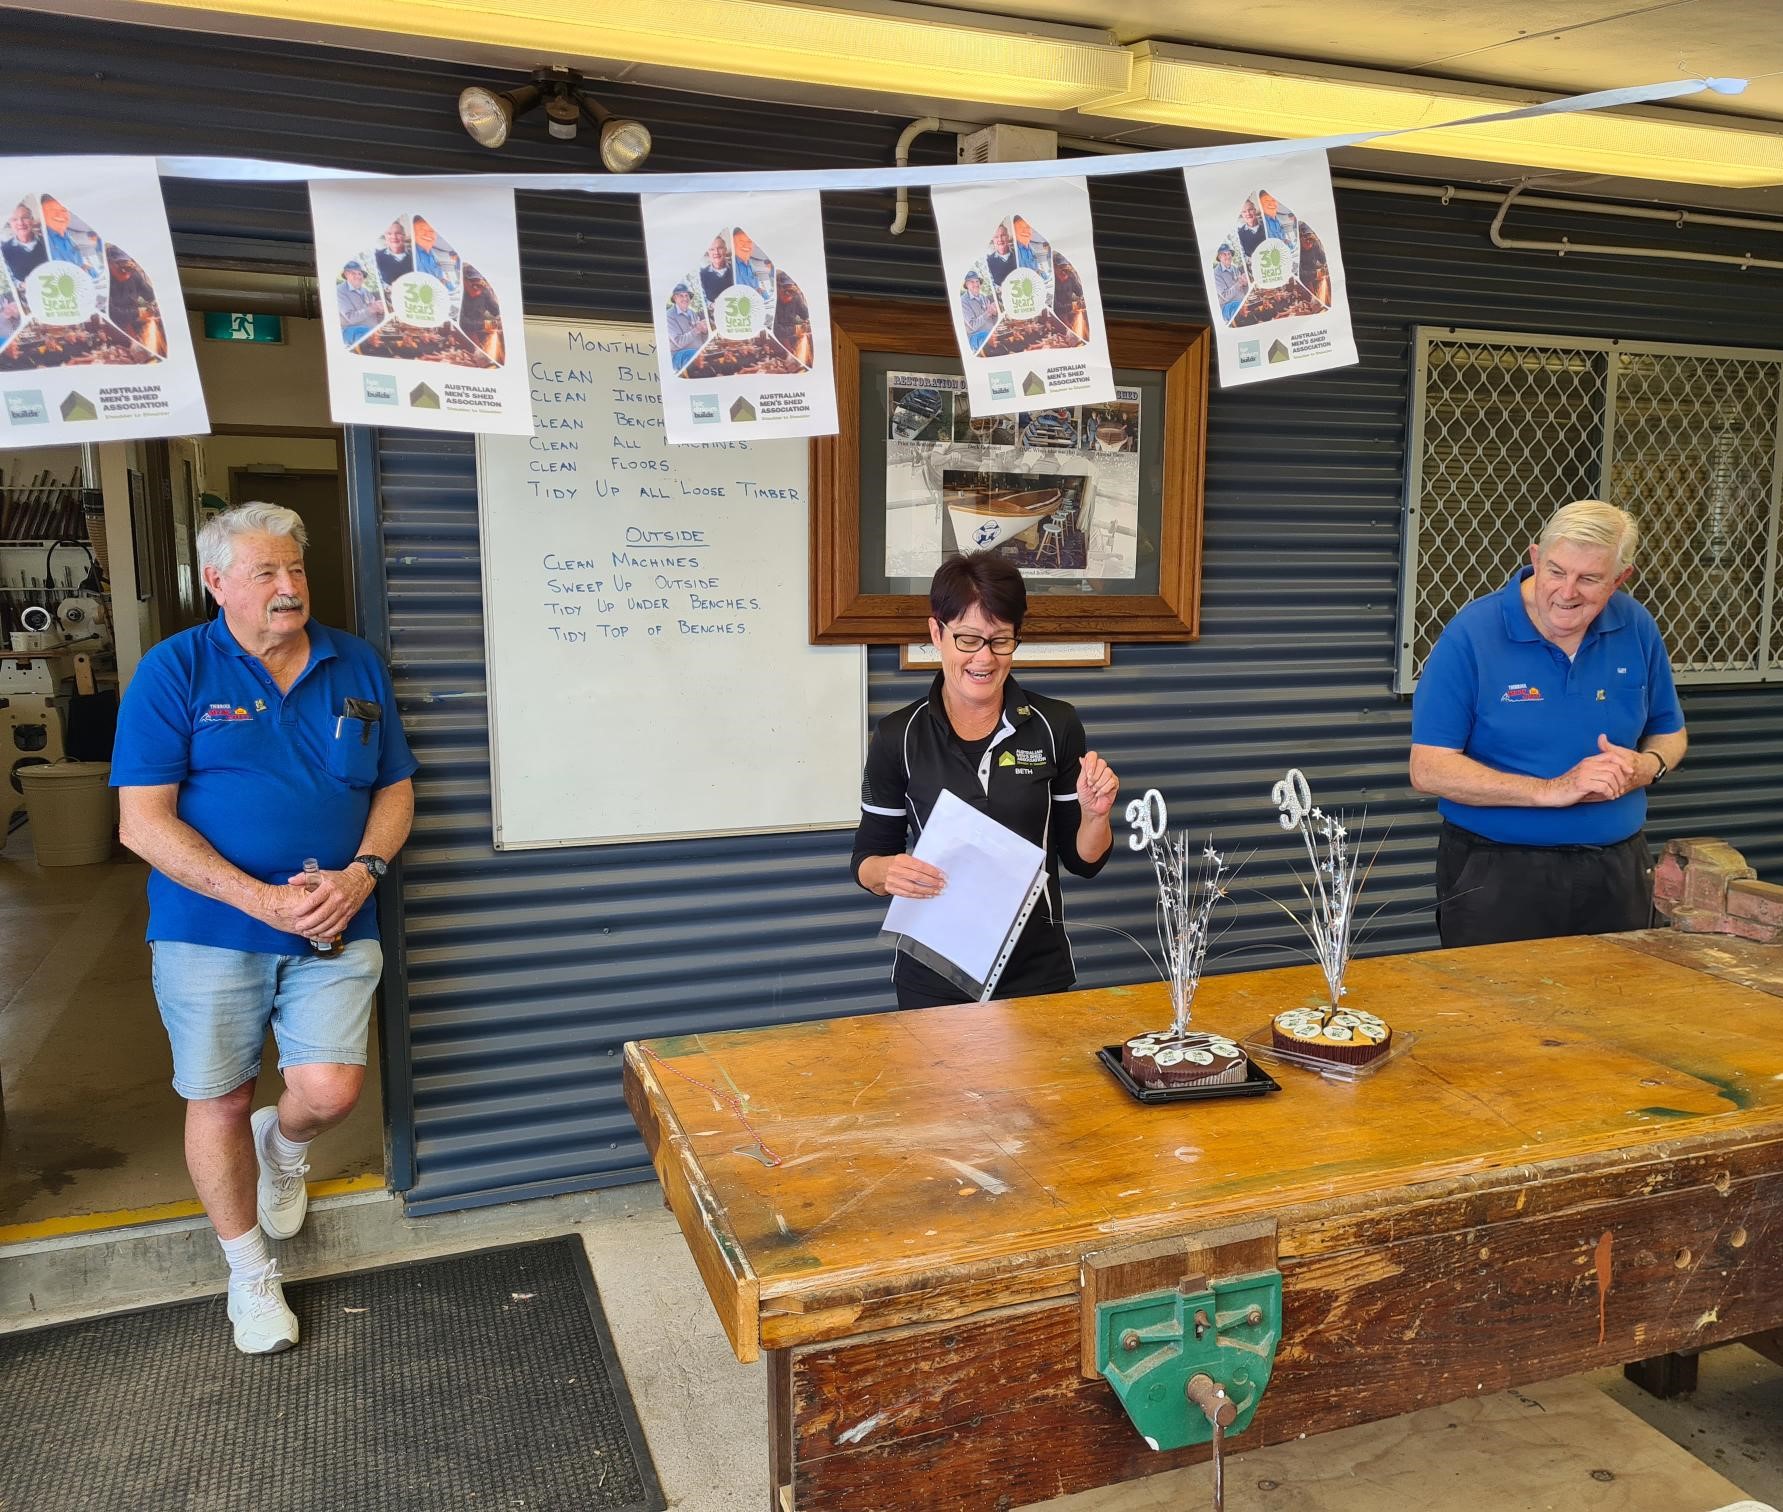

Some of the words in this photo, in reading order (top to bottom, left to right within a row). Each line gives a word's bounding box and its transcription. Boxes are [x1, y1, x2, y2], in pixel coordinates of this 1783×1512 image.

[1259, 248, 1281, 268] 30
[1261, 266, 1282, 278] years
[38, 274, 75, 298] 30
[1009, 278, 1033, 298] 30
[402, 282, 433, 304] 30
[41, 296, 79, 310] years
[724, 296, 751, 317] 30
[1011, 296, 1035, 308] years
[404, 302, 435, 315] years
[726, 315, 752, 328] years
[1290, 329, 1327, 340] AUSTRALIAN
[568, 331, 657, 356] MONTHLY
[1291, 338, 1309, 347] MEN'S
[1310, 336, 1326, 344] SHED
[1292, 342, 1331, 353] ASSOCIATION
[1240, 356, 1256, 364] builds
[531, 361, 593, 384] CLEAN
[1046, 363, 1086, 373] AUSTRALIAN
[1047, 372, 1067, 380] MEN'S
[1048, 376, 1091, 387] ASSOCIATION
[99, 385, 161, 395] AUSTRALIAN
[444, 383, 497, 393] AUSTRALIAN
[893, 375, 959, 388] RESTORATION
[1116, 391, 1138, 400] SHED
[992, 386, 1010, 394] builds
[100, 394, 131, 403] MEN'S
[132, 393, 159, 401] SHED
[367, 390, 391, 399] builds
[444, 391, 471, 399] MEN'S
[530, 389, 587, 403] CLEAN
[612, 389, 663, 404] INSIDE
[760, 392, 806, 400] AUSTRALIAN
[102, 401, 169, 411] ASSOCIATION
[446, 398, 502, 408] ASSOCIATION
[761, 405, 810, 413] ASSOCIATION
[11, 409, 40, 418] builds
[529, 436, 579, 451] CLEAN
[613, 435, 641, 449] ALL
[529, 461, 577, 472] CLEAN
[527, 481, 577, 499] TIDY
[595, 479, 620, 497] UP
[640, 487, 671, 499] ALL
[680, 480, 726, 497] LOOSE
[626, 526, 705, 543] OUTSIDE
[543, 554, 594, 570] CLEAN
[547, 579, 604, 593] SWEEP
[613, 574, 633, 592] UP
[654, 574, 720, 589] OUTSIDE
[544, 603, 582, 616] TIDY
[597, 597, 615, 613] UP
[627, 597, 670, 610] UNDER
[690, 593, 761, 610] BENCHES.
[548, 626, 587, 642] TIDY
[596, 624, 629, 639] TOP
[647, 625, 662, 636] OF
[1271, 768, 1312, 831] 30
[1125, 789, 1168, 851] 30
